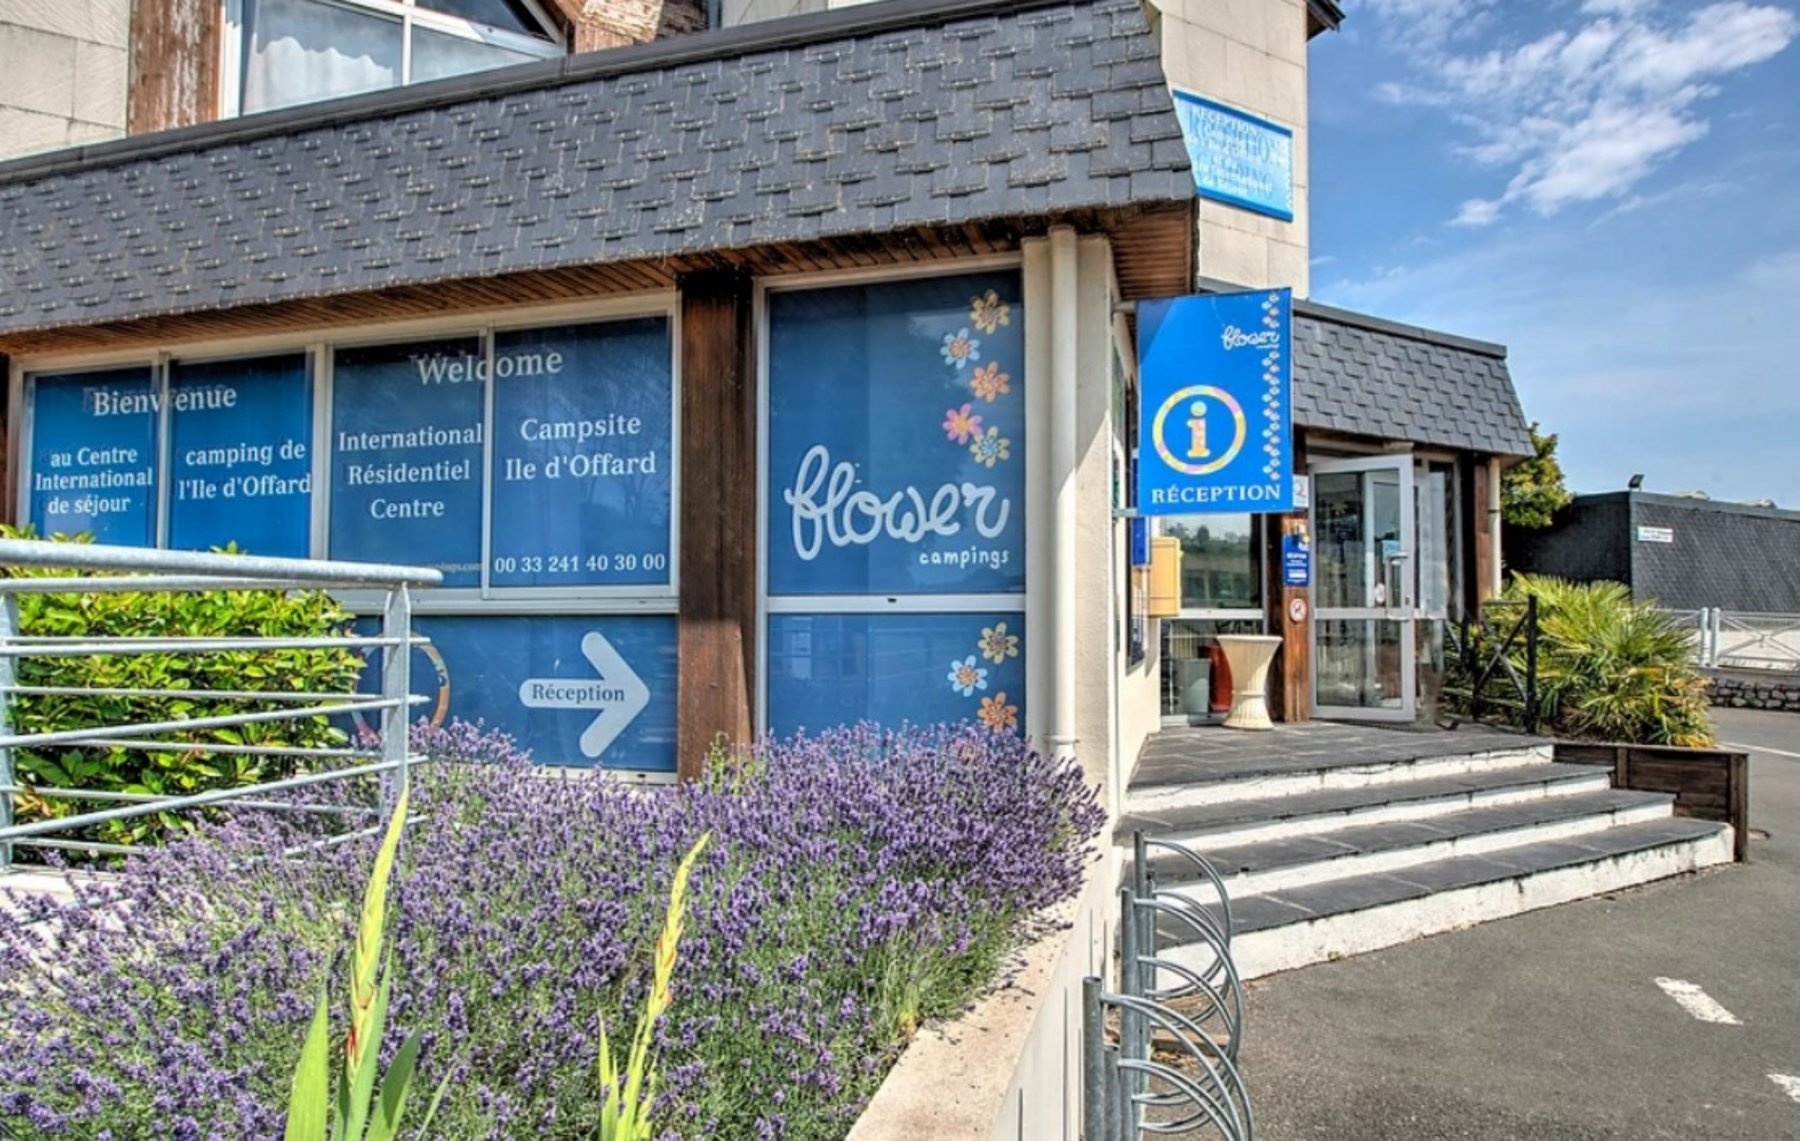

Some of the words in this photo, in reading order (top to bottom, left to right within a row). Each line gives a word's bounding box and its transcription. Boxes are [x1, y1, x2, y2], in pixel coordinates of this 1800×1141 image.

[418, 351, 563, 384] Welcome
[94, 388, 237, 416] Bienvenue
[338, 423, 483, 452] International
[520, 413, 642, 443] Campsite
[50, 450, 72, 467] au
[77, 446, 138, 466] Centre
[185, 442, 273, 468] camping
[279, 439, 306, 460] de
[505, 458, 537, 481] Ile
[544, 451, 657, 479] d'Offard
[35, 467, 153, 491] International
[347, 460, 471, 485] Résidentiel
[179, 480, 217, 500] l'Ile
[223, 473, 311, 498] d'Offard
[1151, 483, 1281, 504] RÉCEPTION
[48, 499, 69, 514] de
[74, 496, 132, 518] séjour
[370, 499, 445, 520] Centre
[784, 445, 1010, 560] flower
[495, 557, 516, 573] 00
[520, 556, 542, 572] 33
[548, 555, 580, 572] 241
[585, 555, 608, 571] 40
[614, 554, 637, 570] 30
[642, 553, 666, 569] 00
[919, 546, 1010, 570] campings
[531, 684, 625, 704] Réception
